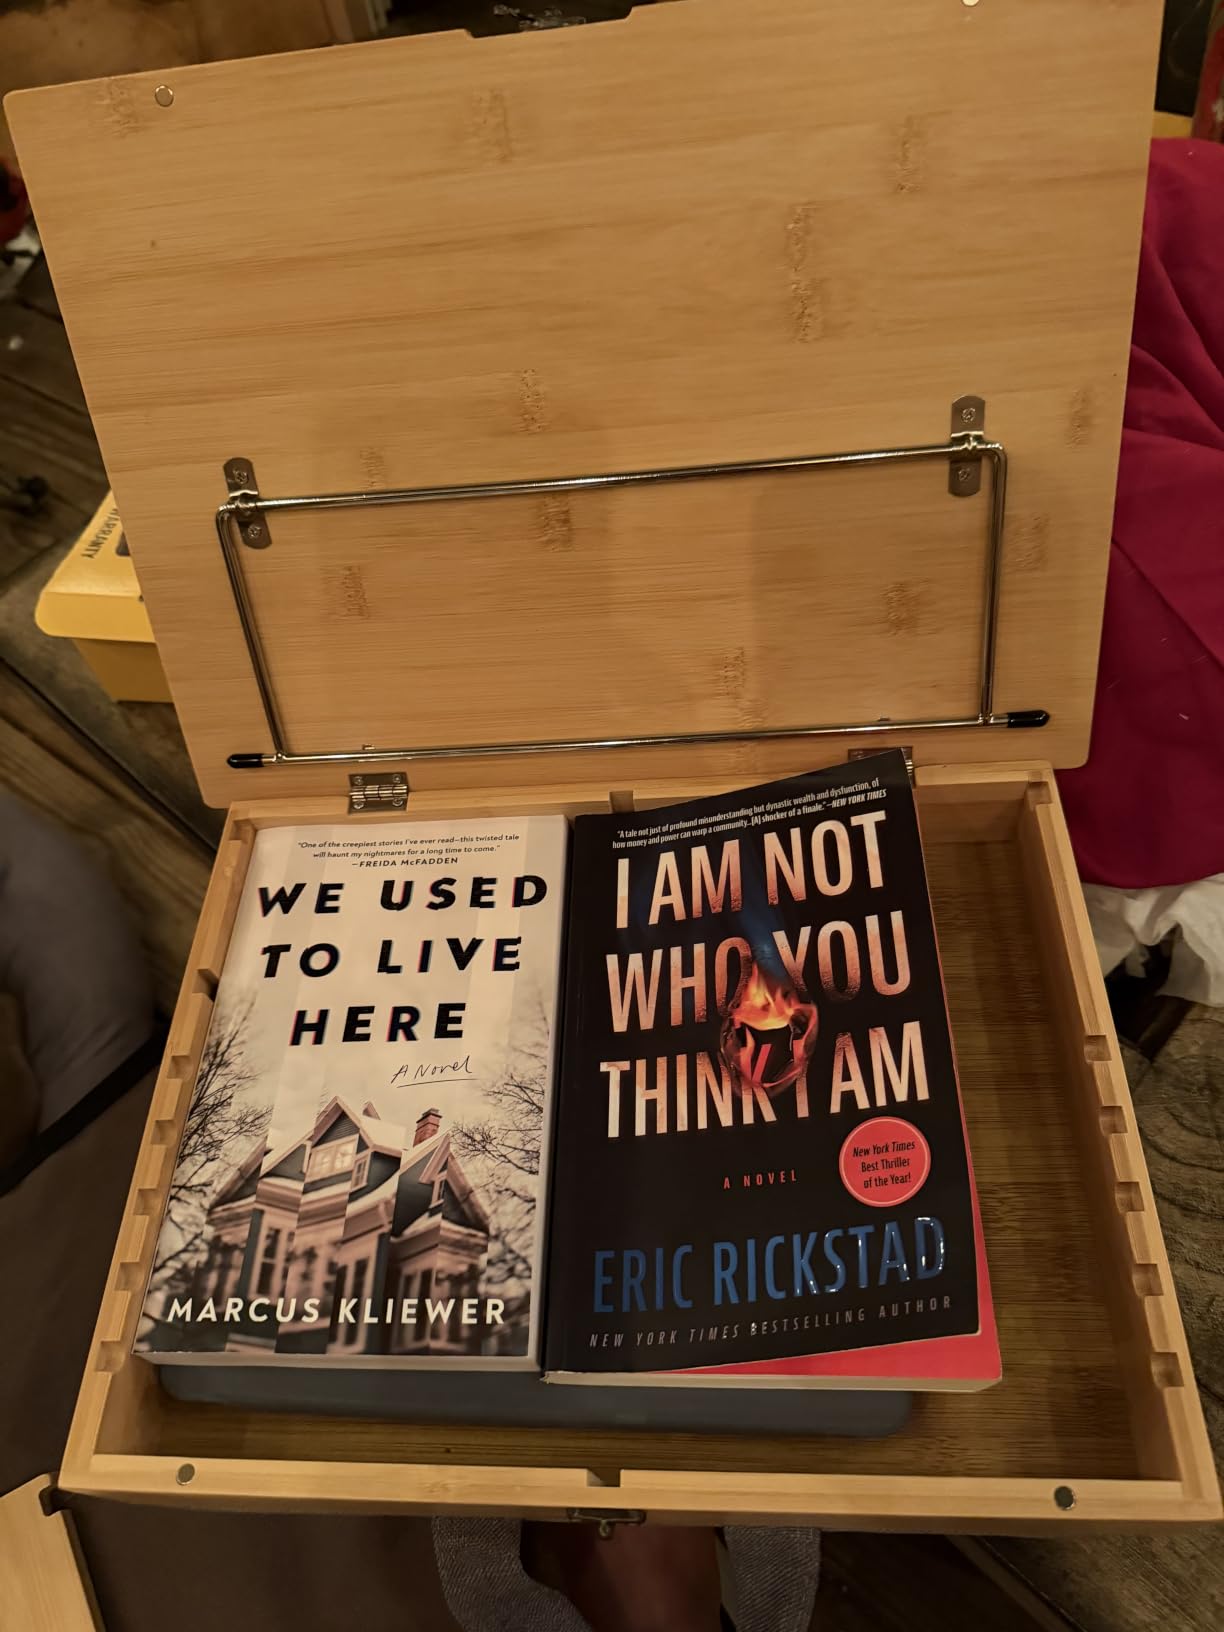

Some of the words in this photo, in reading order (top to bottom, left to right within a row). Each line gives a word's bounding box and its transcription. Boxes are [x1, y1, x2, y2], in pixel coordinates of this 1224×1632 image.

[612, 840, 626, 849] how
[626, 838, 647, 848] money
[647, 835, 660, 845] and
[660, 833, 680, 844] power
[680, 831, 691, 839] can
[691, 827, 708, 837] warp
[762, 808, 787, 822] shocker
[788, 807, 796, 817] of
[796, 807, 802, 816] a
[847, 793, 866, 805] YORK
[866, 788, 887, 801] TIMES
[625, 828, 638, 838] tale
[638, 827, 649, 837] not
[649, 826, 661, 838] just
[661, 824, 669, 834] of
[669, 818, 698, 833] profound
[698, 806, 754, 826] misunderstanding
[753, 803, 765, 814] but
[765, 799, 792, 812] dynastic
[793, 792, 816, 805] wealth
[816, 789, 829, 800] and
[830, 781, 871, 798] dysfunction,
[872, 777, 880, 788] of
[363, 850, 406, 858] nightmares
[400, 857, 458, 866] McFADDEN
[616, 857, 630, 929] I
[648, 838, 743, 926] AM
[763, 810, 887, 906] NOT
[258, 882, 344, 917] WE
[380, 875, 548, 912] USED
[261, 942, 340, 978] TO
[377, 936, 522, 974] LIVE
[606, 936, 753, 1033] WHO
[772, 910, 911, 1000] YOU
[289, 1003, 467, 1046] HERE
[391, 1064, 409, 1084] A
[413, 1055, 473, 1080] Novel
[599, 1042, 777, 1138] THINK
[792, 1040, 809, 1118] I
[829, 1021, 930, 1114] AM
[853, 1147, 870, 1157] New
[873, 1142, 890, 1155] York
[892, 1141, 915, 1153] Times
[861, 1161, 879, 1173] Best
[881, 1157, 910, 1170] Thriller
[723, 1176, 731, 1190] A
[743, 1169, 797, 1187] NOVEL
[864, 1177, 873, 1189] of
[874, 1176, 888, 1187] the
[890, 1172, 911, 1185] Year!
[593, 1243, 694, 1313] ERIC
[713, 1215, 945, 1306] RICKSTAD
[166, 1297, 322, 1324] MARCUS
[337, 1297, 505, 1325] KLIEWER
[589, 1333, 624, 1347] NEW
[636, 1330, 678, 1346] YORK
[689, 1324, 740, 1343] TIMES
[750, 1308, 865, 1337] BESTSELLING
[878, 1296, 951, 1319] AUTHOR
